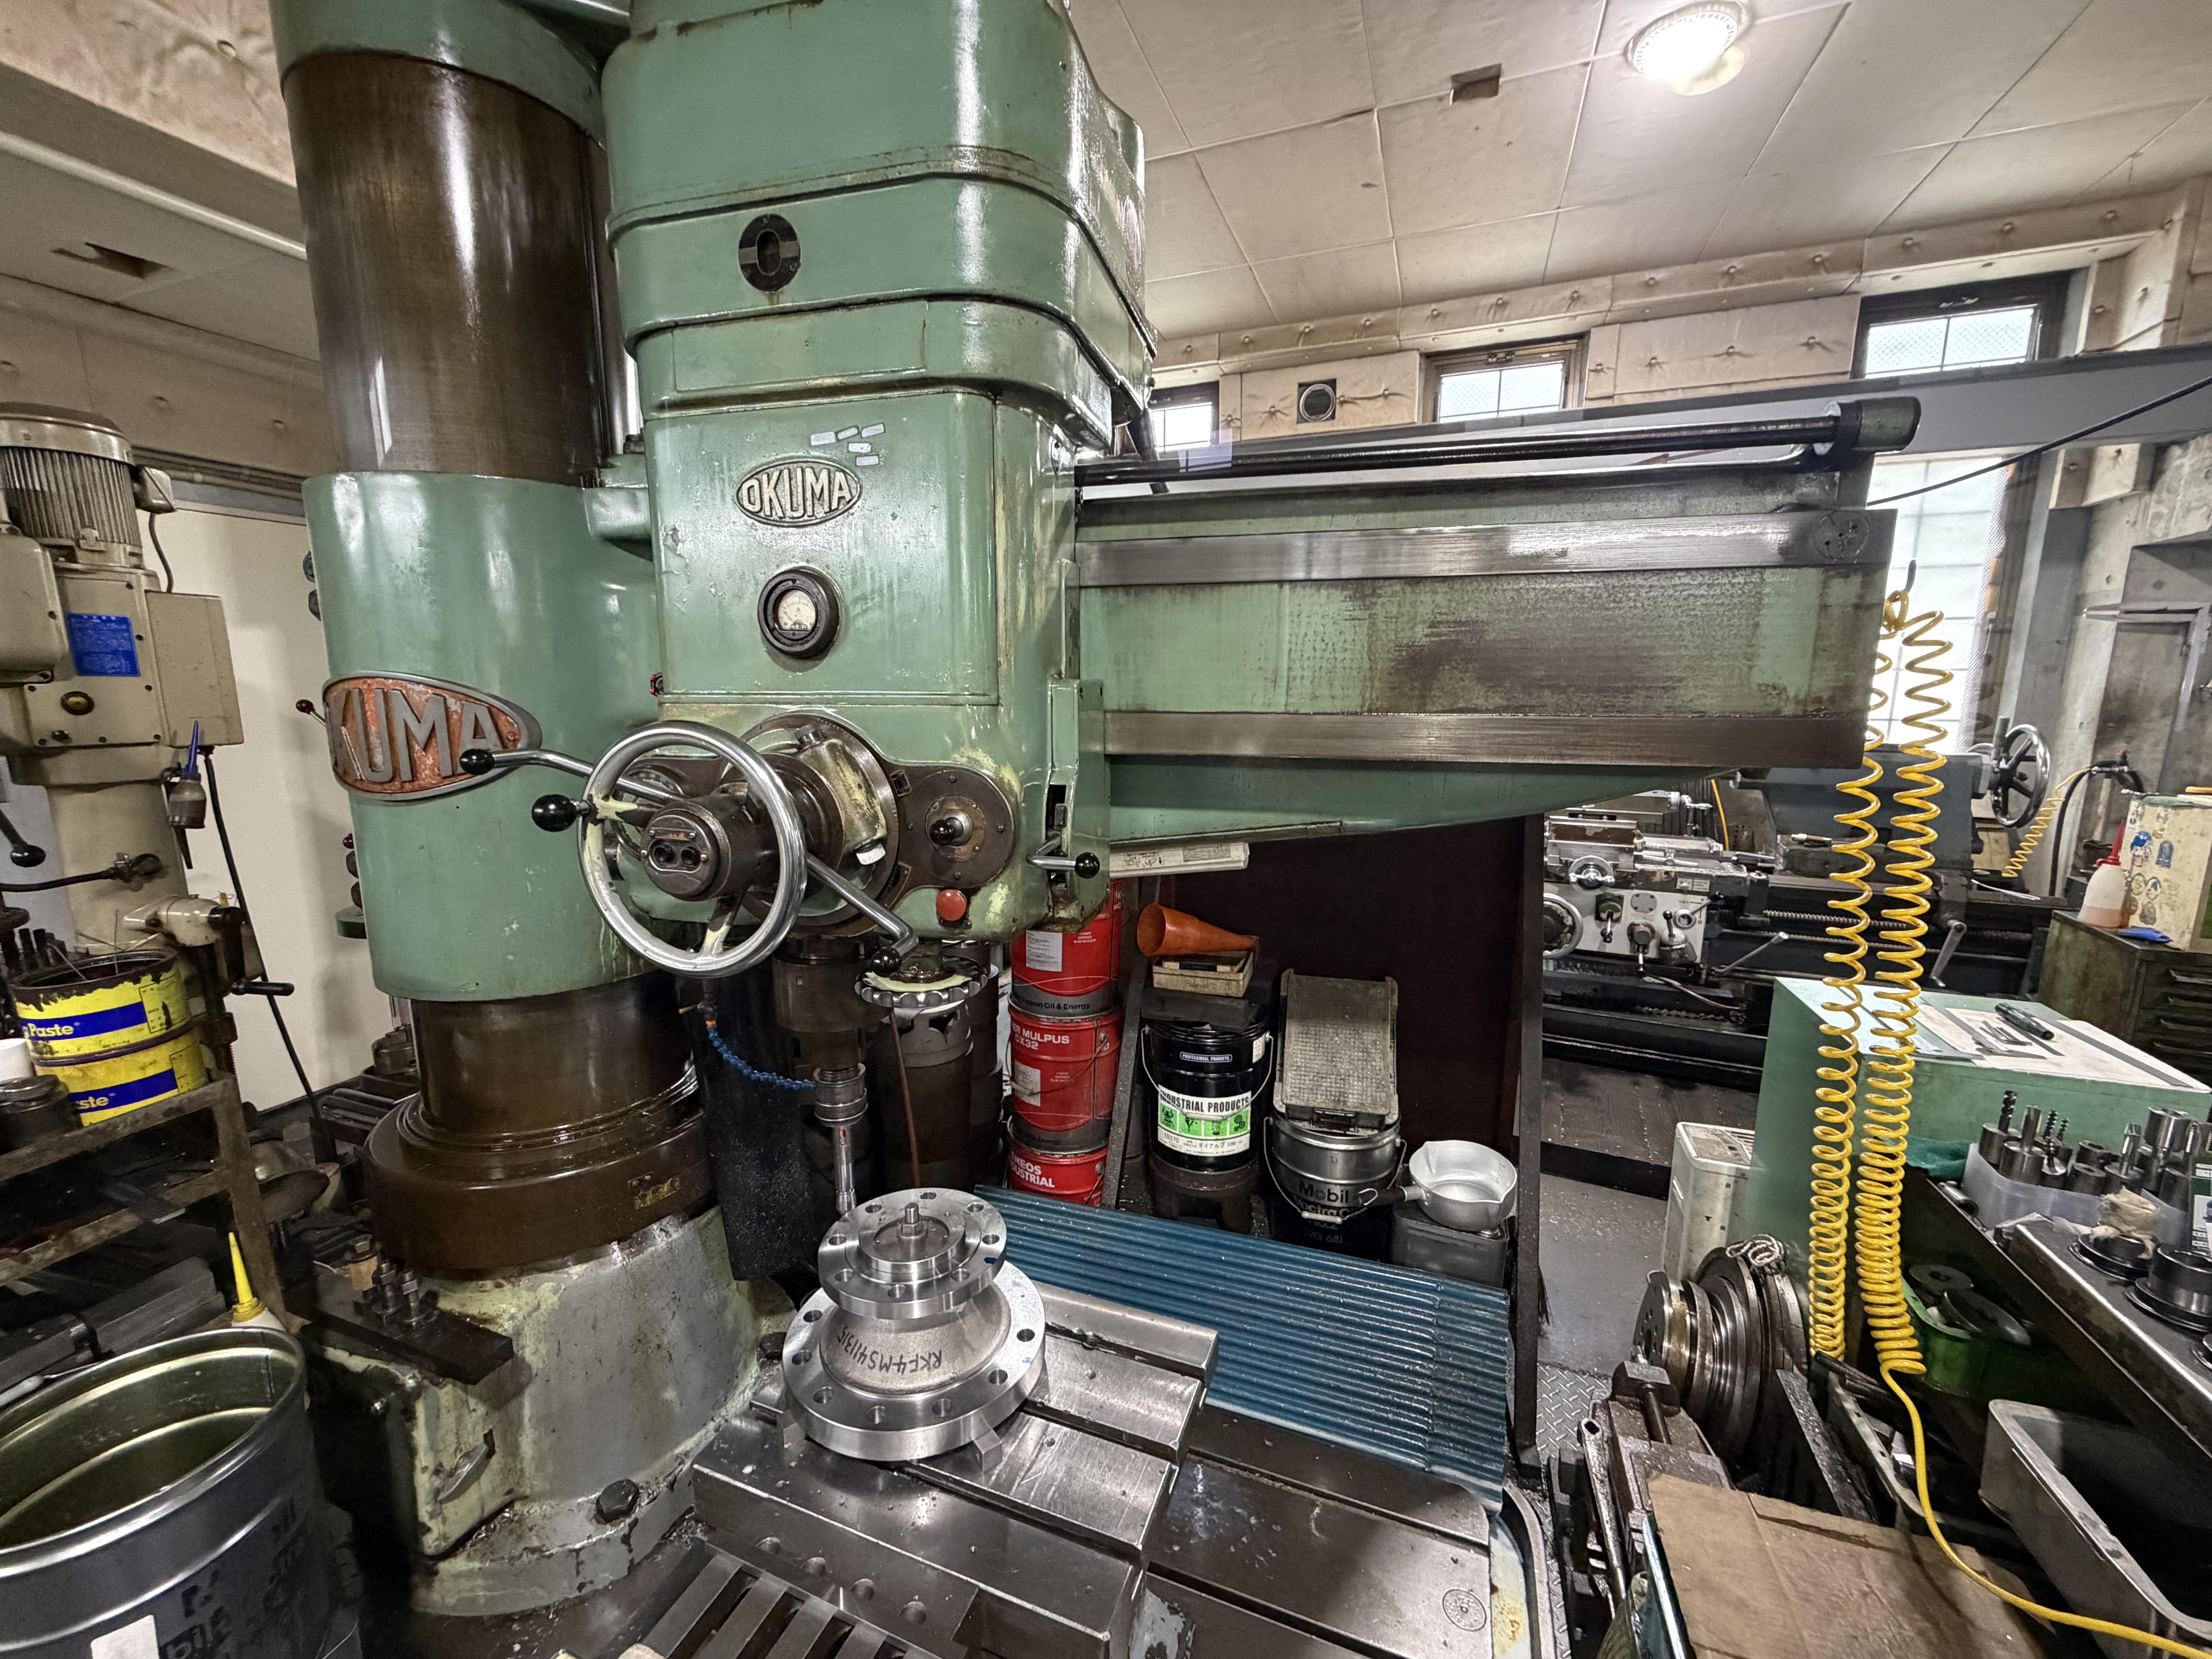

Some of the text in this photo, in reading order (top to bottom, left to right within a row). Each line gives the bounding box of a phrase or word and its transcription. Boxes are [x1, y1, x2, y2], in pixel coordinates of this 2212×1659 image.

[742, 467, 852, 518] OKUMA
[326, 687, 505, 782] KUMA
[28, 1023, 74, 1037] Paste
[1022, 1028, 1070, 1044] MULPUS
[75, 1096, 109, 1110] ste
[1160, 1089, 1204, 1113] INDUSTRIAL
[1299, 1180, 1348, 1203] Mobil
